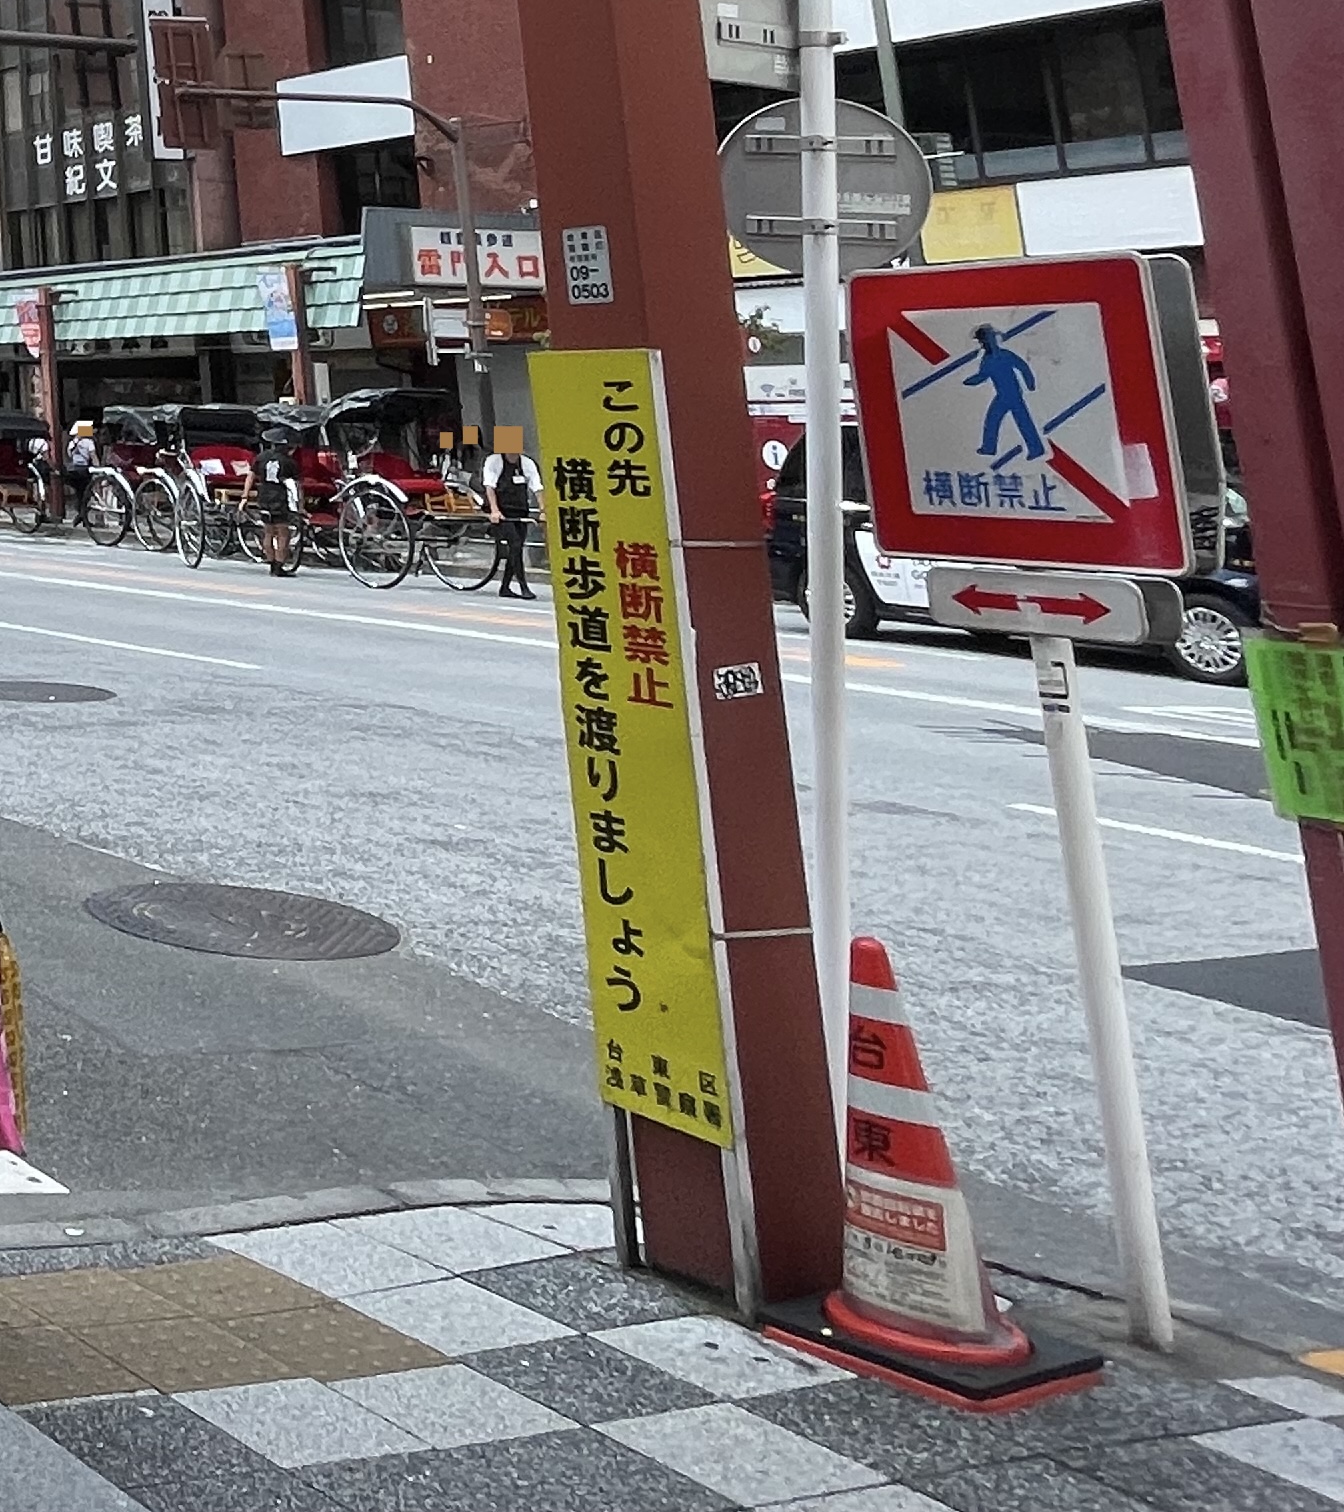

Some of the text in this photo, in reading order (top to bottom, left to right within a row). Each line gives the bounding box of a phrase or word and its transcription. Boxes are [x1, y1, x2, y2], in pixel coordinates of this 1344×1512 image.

[33, 113, 144, 165] 甘味喫茶
[64, 158, 118, 196] 紀文
[417, 248, 540, 280] 雷門入口
[570, 265, 599, 281] 09-
[572, 282, 609, 299] 0503
[602, 379, 651, 498] この先
[922, 469, 1068, 511] 横断禁止
[612, 540, 674, 710] 横断禁止
[552, 456, 645, 1012] 横断歩道を渡りましょう
[606, 1038, 719, 1097] 台東区
